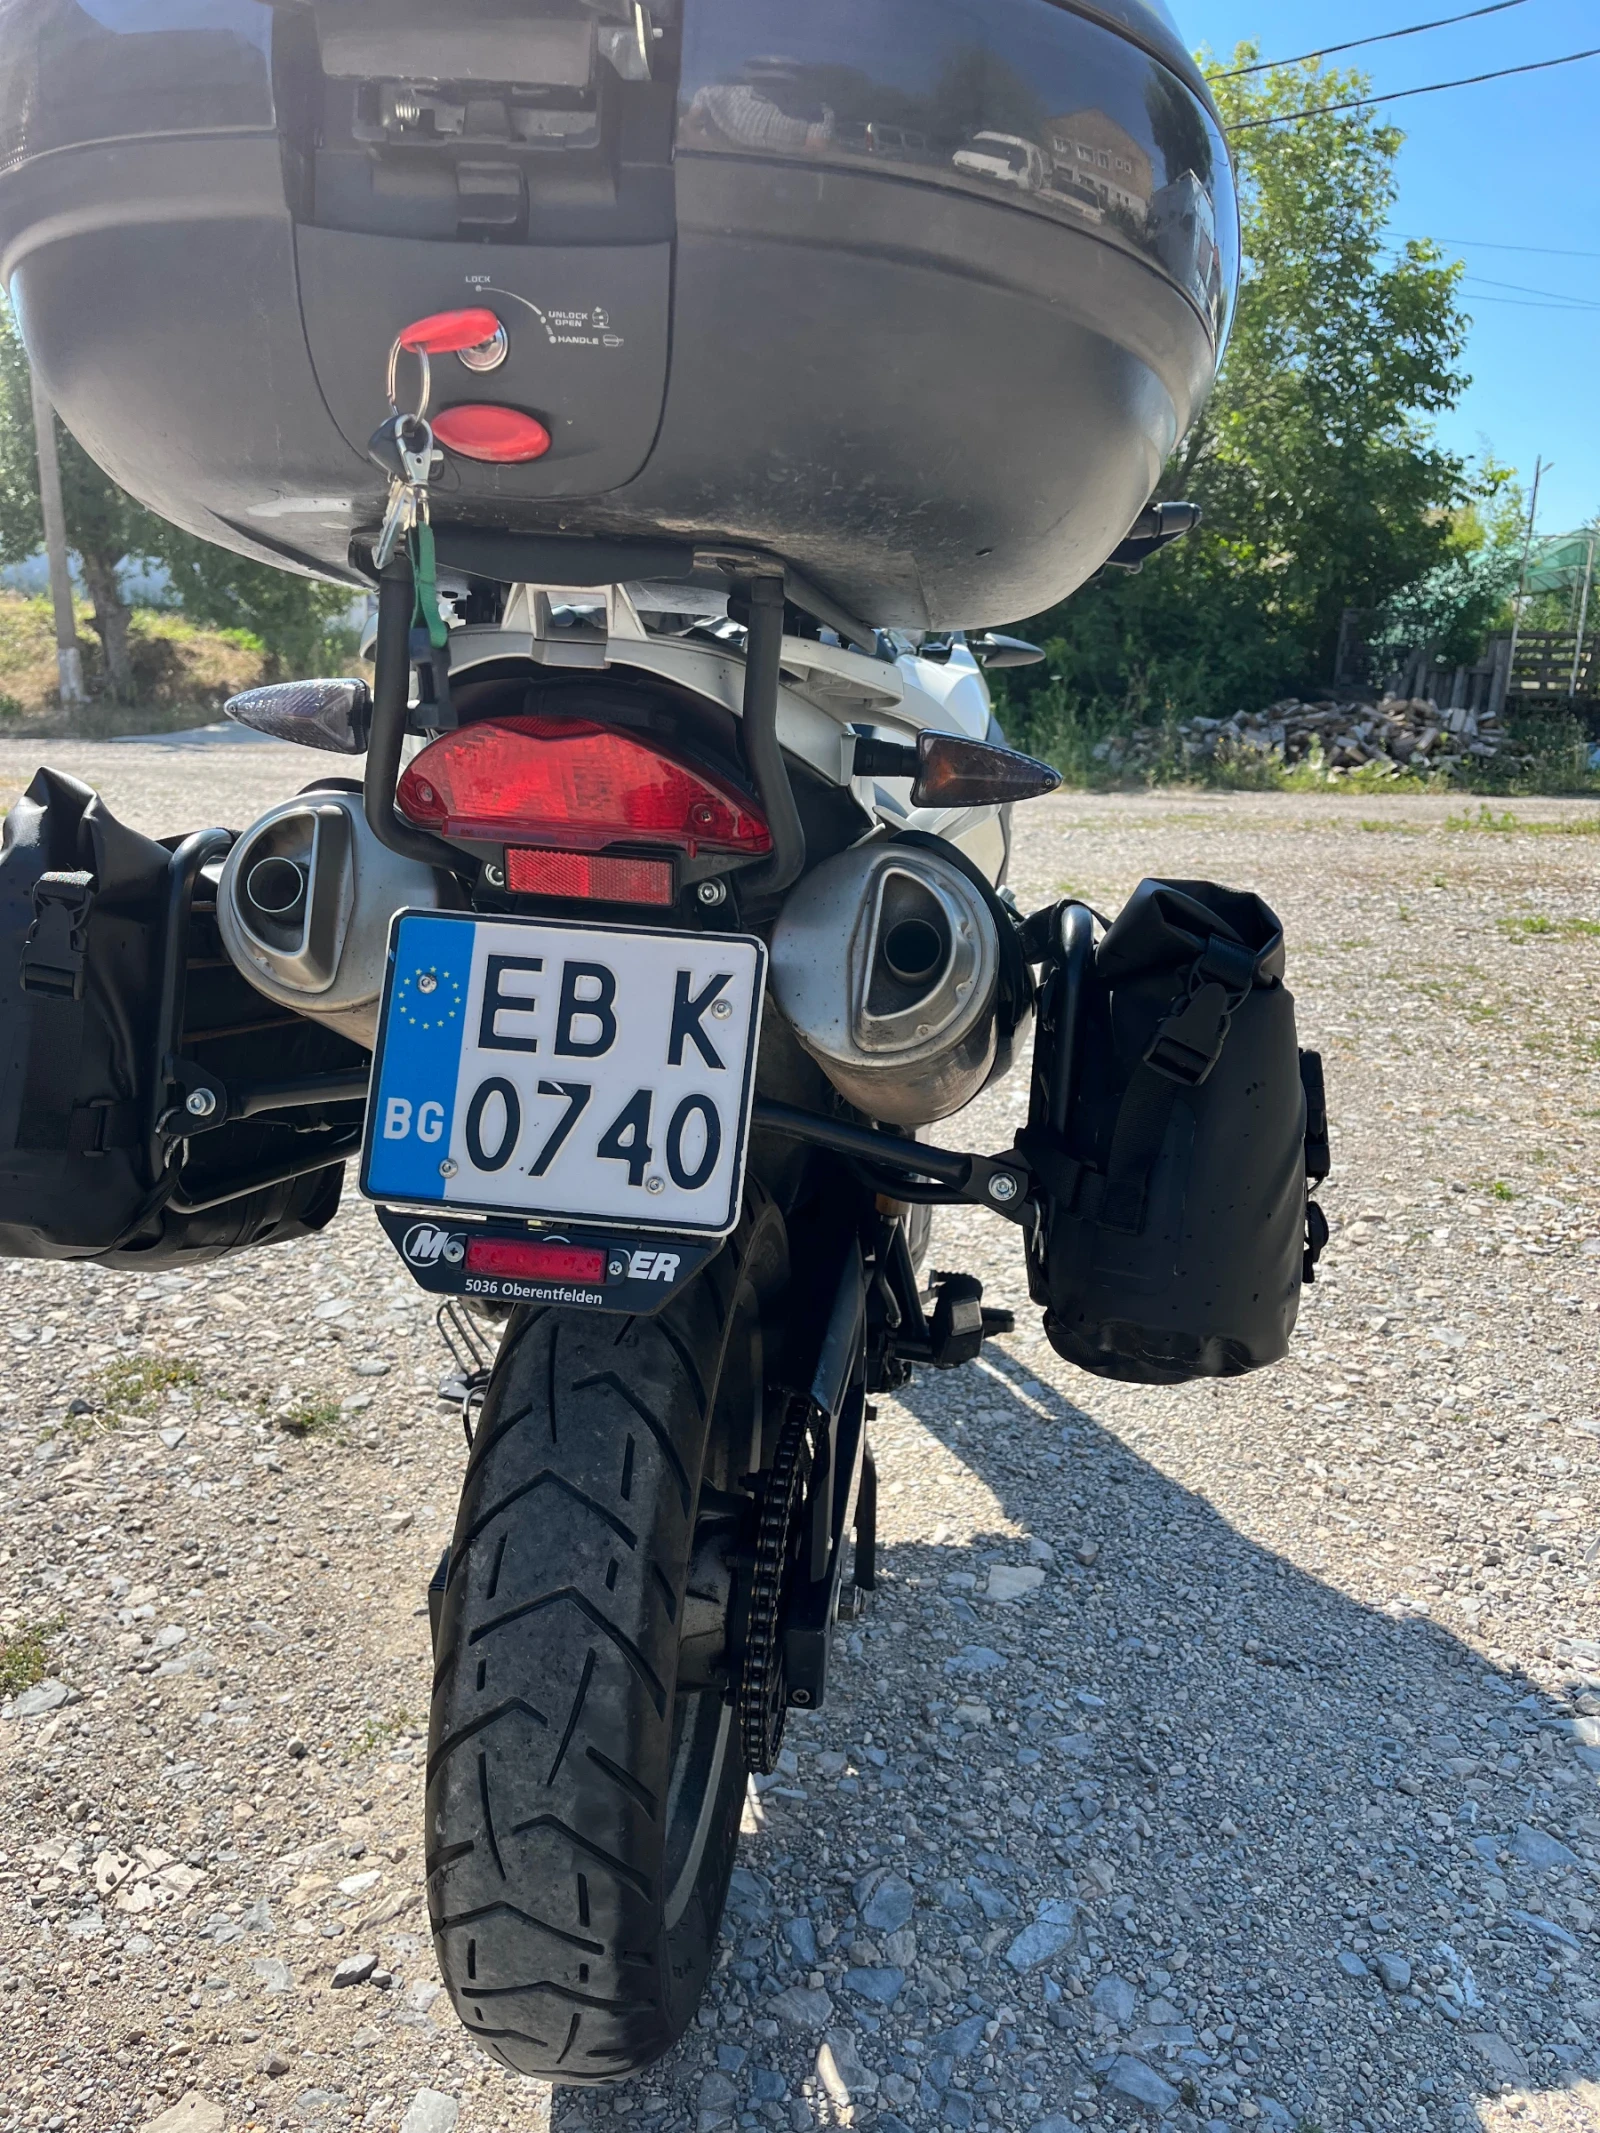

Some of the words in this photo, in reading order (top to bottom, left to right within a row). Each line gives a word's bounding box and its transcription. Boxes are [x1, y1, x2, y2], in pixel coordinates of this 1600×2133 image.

[465, 275, 491, 283] LOCK
[548, 310, 589, 321] UNLOCK
[555, 318, 582, 328] OPEN
[557, 335, 599, 345] HANDLE
[477, 953, 618, 1058] EB
[666, 970, 734, 1070] K
[383, 1096, 445, 1143] BG
[465, 1076, 722, 1191] 0740
[465, 1279, 498, 1294] 5036
[501, 1282, 603, 1305] Oberentfelden
